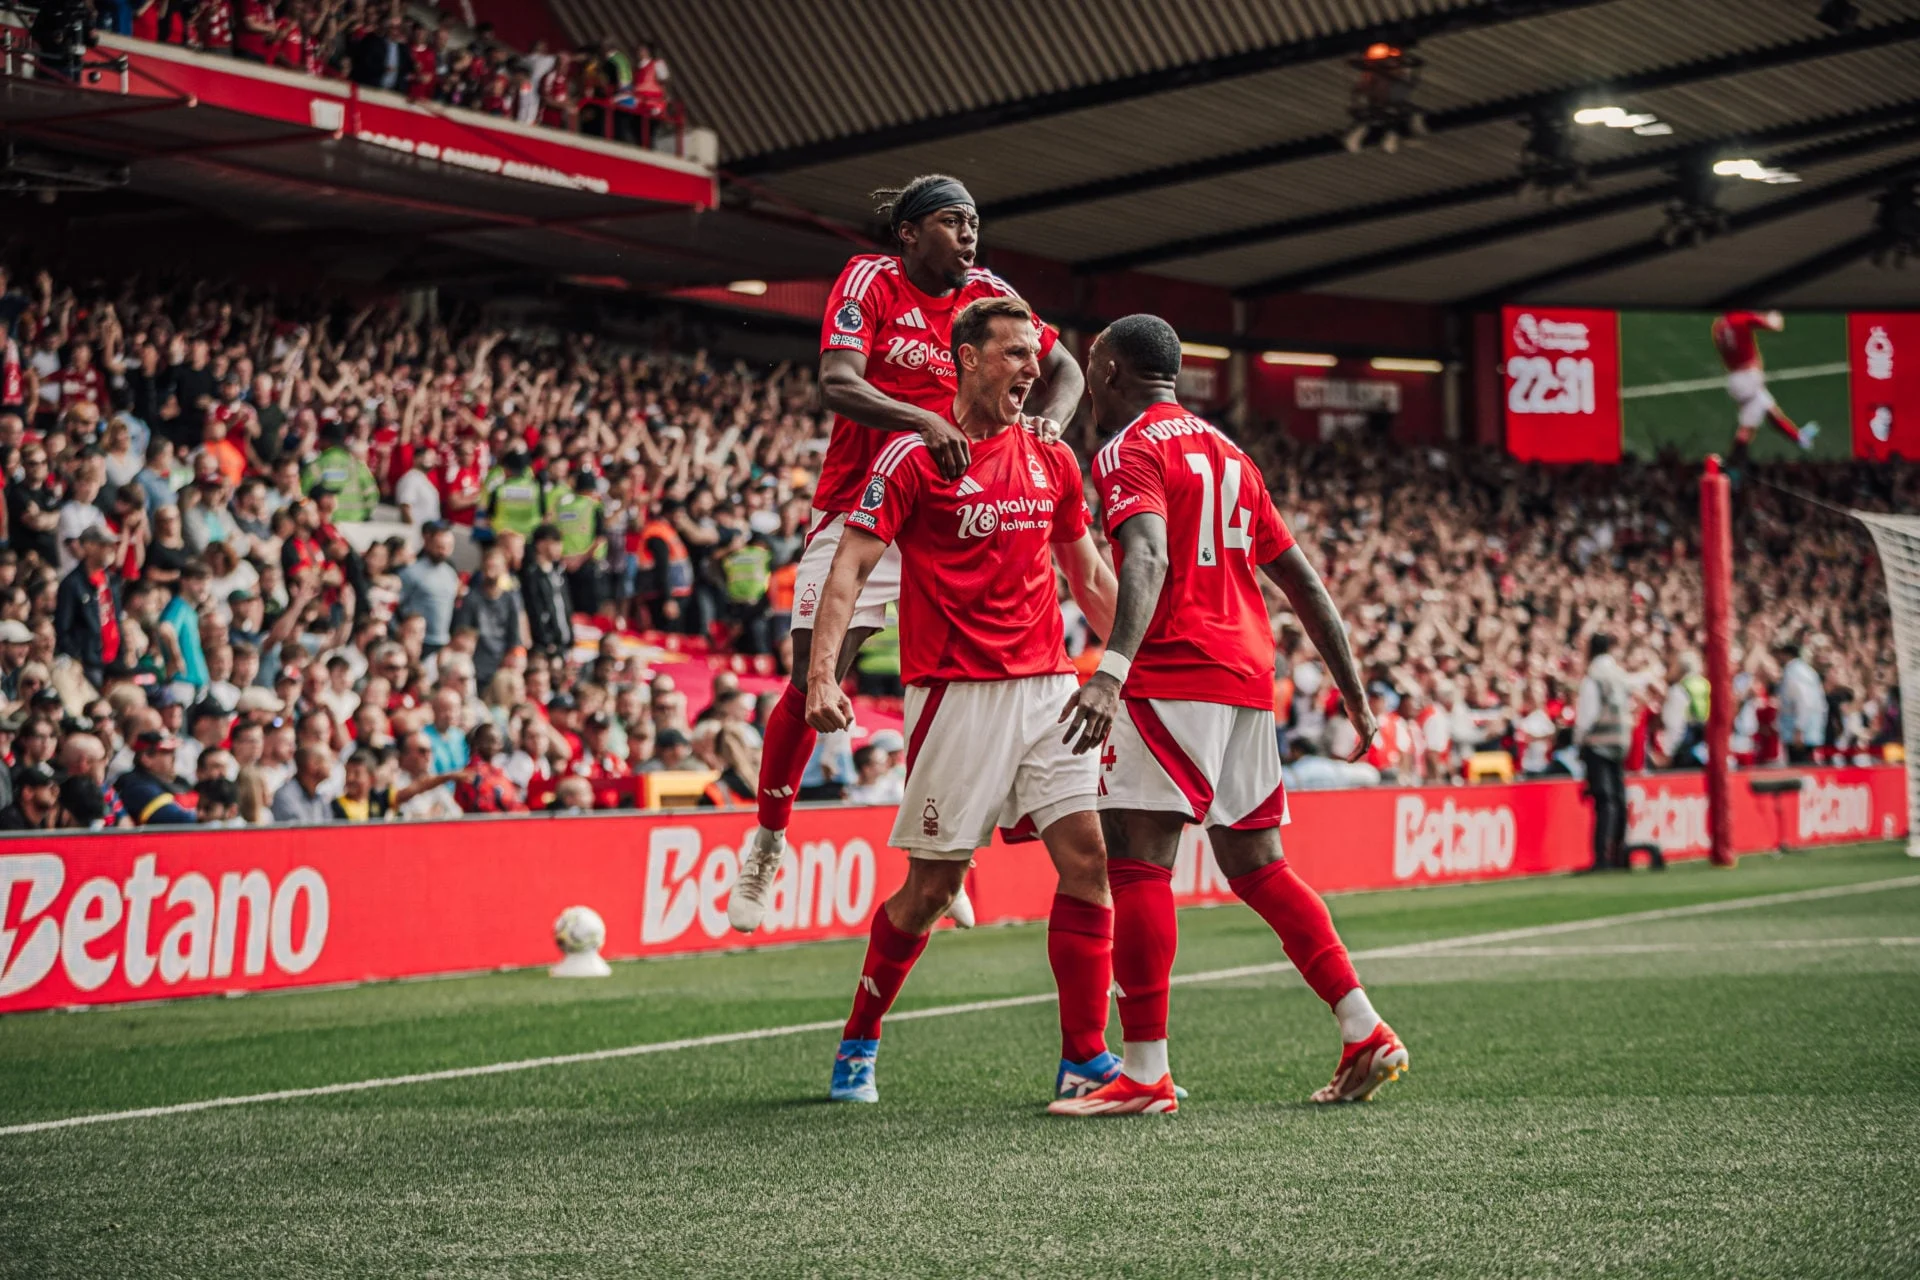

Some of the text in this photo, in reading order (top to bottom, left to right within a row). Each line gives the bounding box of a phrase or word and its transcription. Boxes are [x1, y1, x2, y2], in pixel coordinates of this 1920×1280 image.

[996, 496, 1054, 515] kaiyun
[1185, 453, 1253, 567] 14
[641, 825, 877, 945] Beano
[1393, 794, 1517, 880] Betano
[0, 852, 330, 998] Betano
